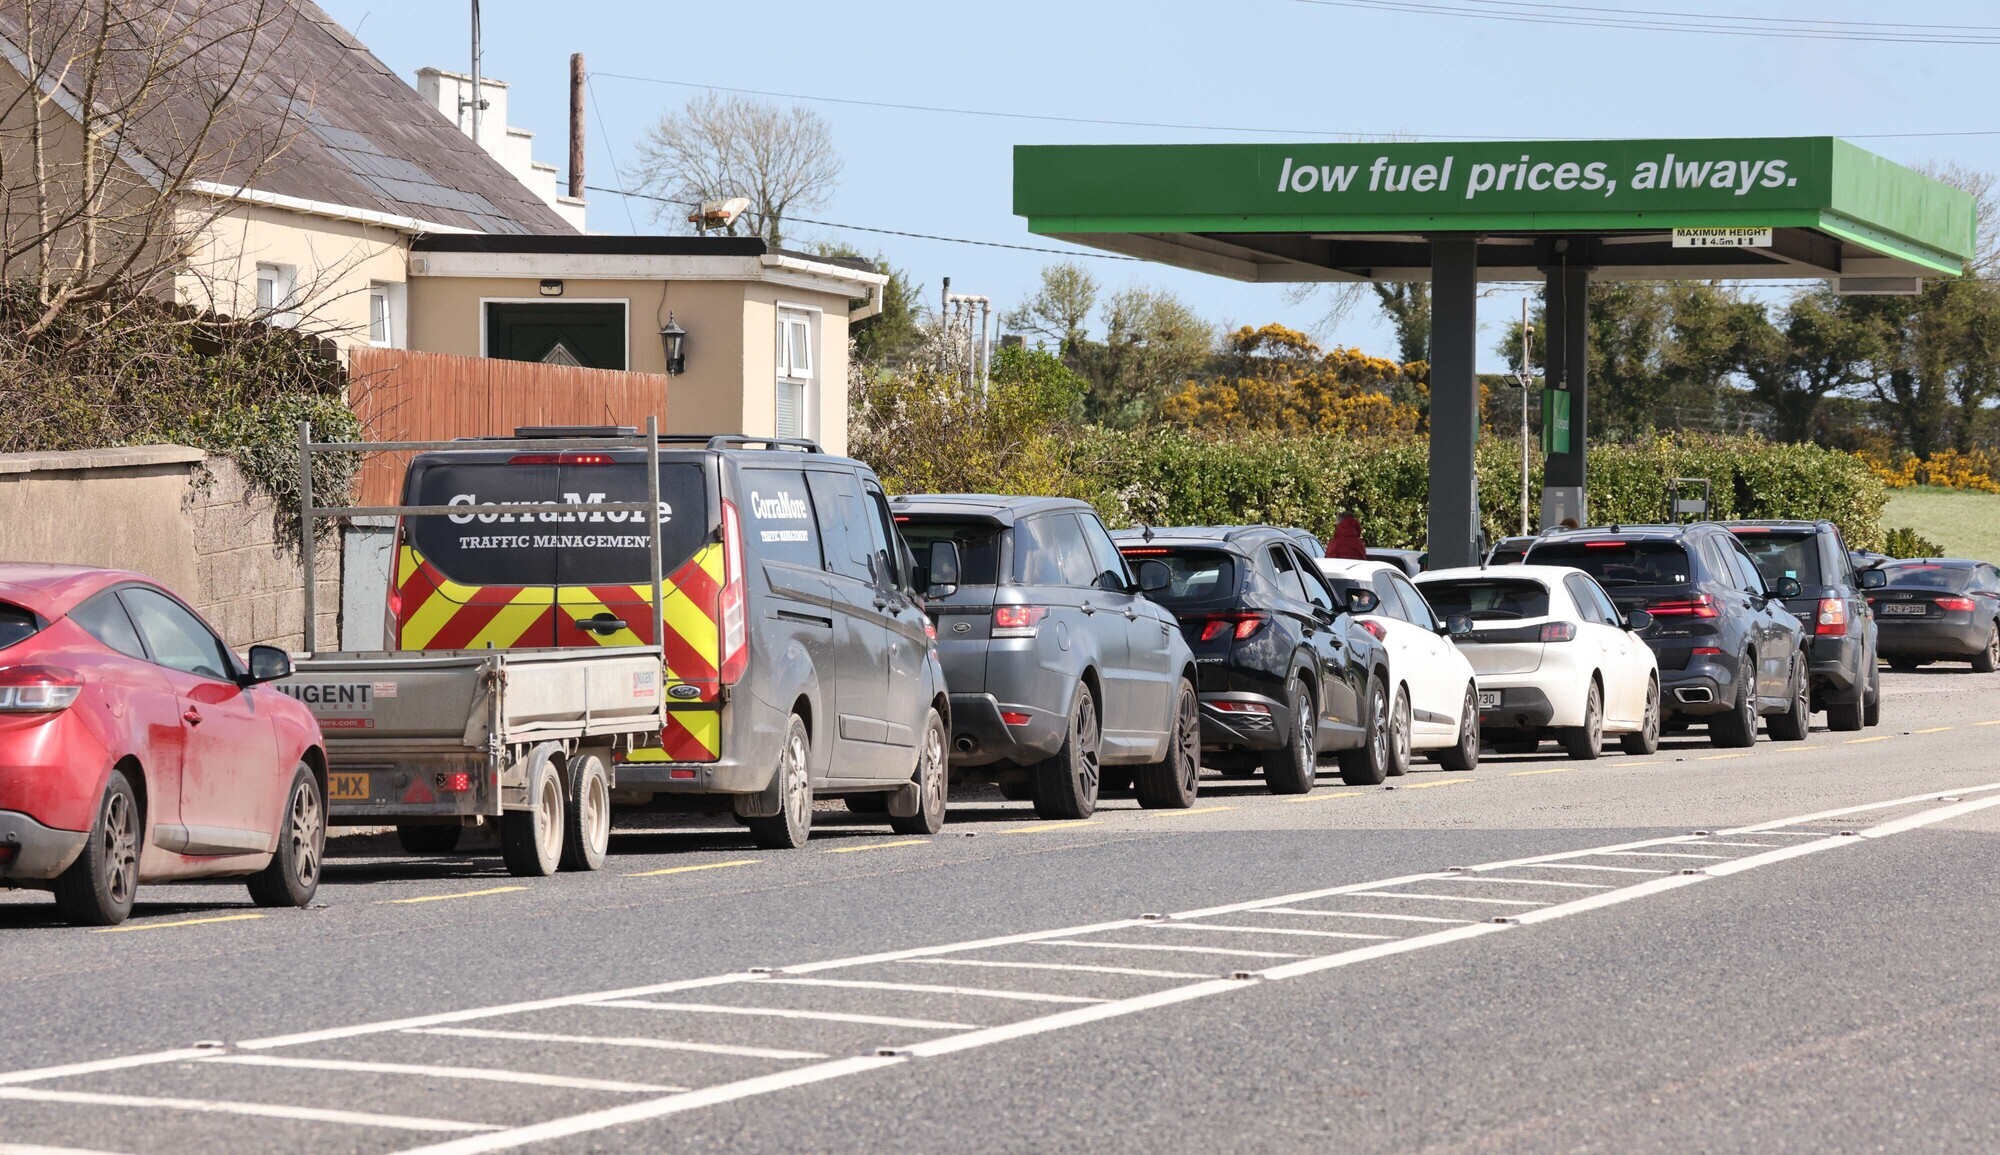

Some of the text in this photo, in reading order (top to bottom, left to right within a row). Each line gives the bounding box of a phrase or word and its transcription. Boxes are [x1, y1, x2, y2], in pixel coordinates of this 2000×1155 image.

[1277, 153, 1799, 199] low fuel prices, always.
[1729, 228, 1768, 236] HEIGHT
[448, 493, 672, 524] CorraMore
[751, 491, 807, 519] CorraMore
[459, 536, 529, 549] TRAFFIC
